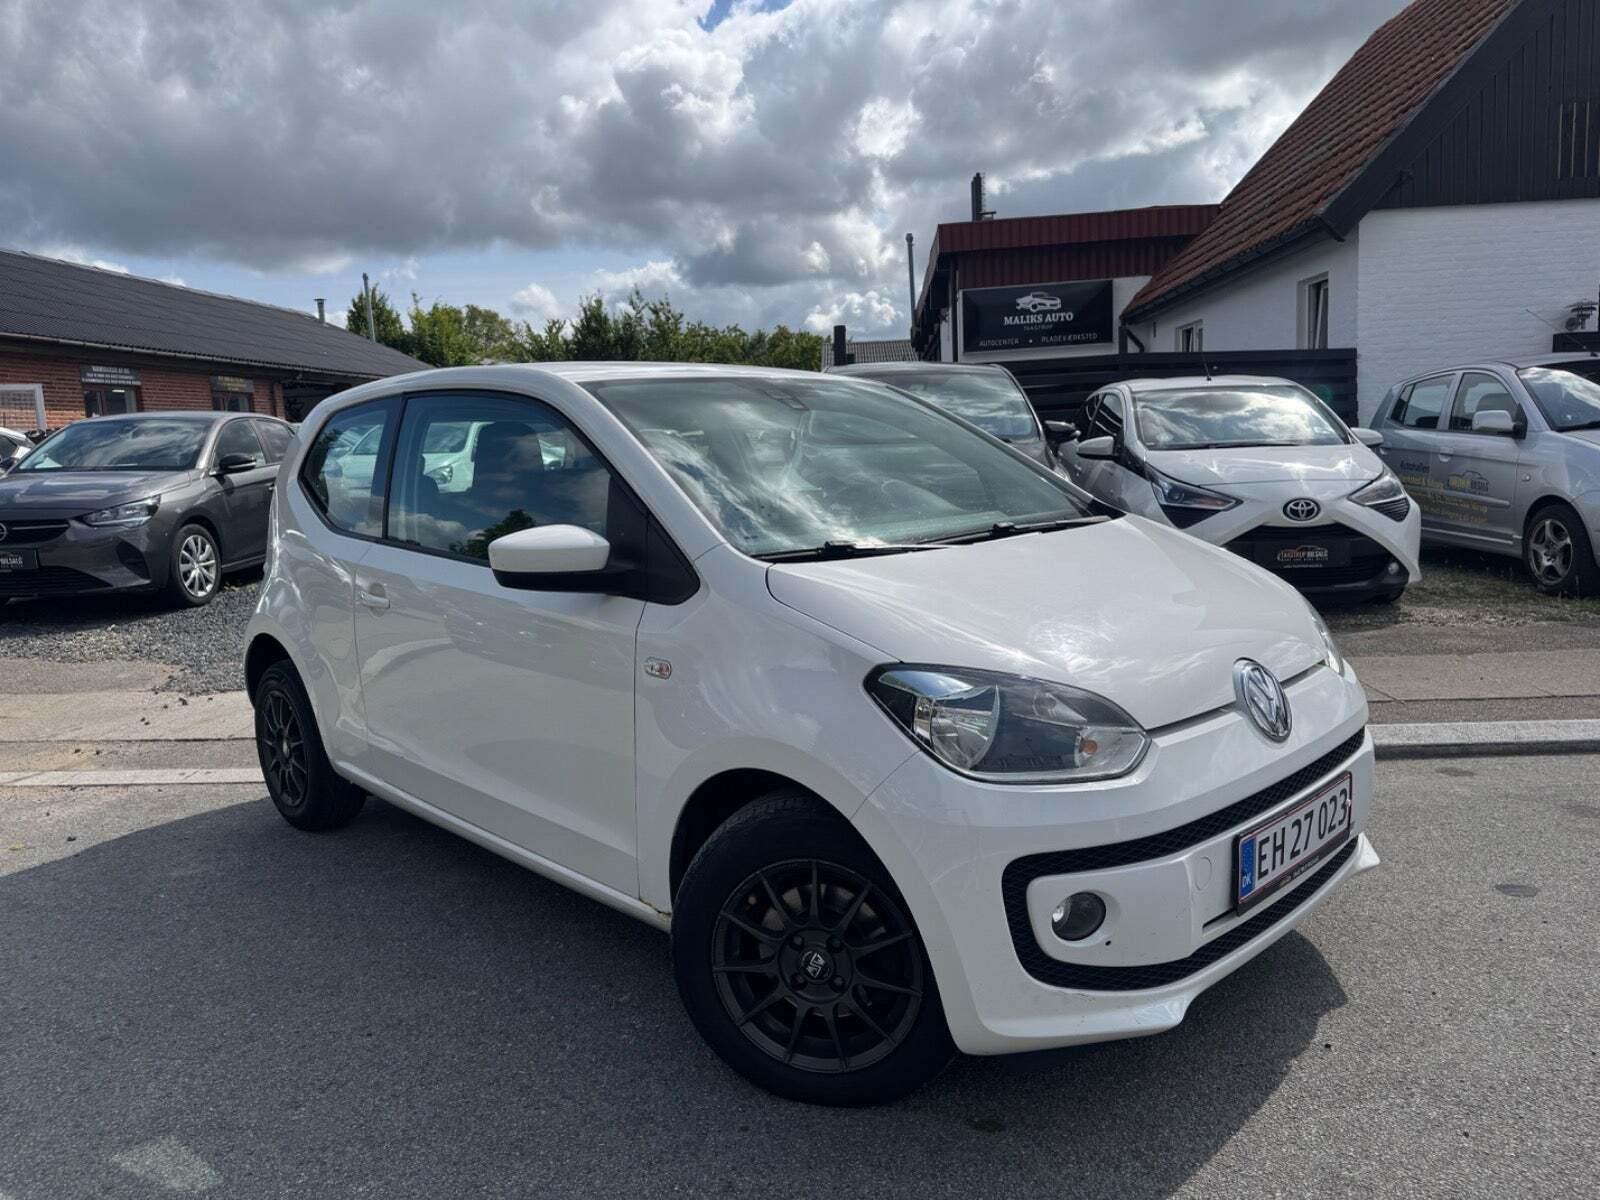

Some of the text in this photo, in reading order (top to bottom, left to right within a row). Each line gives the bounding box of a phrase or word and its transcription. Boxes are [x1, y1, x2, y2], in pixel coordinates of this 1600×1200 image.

[1004, 312, 1074, 326] MALIKS AUTO
[1257, 827, 1286, 880] EH
[1289, 809, 1314, 860] 27
[1318, 788, 1348, 839] 023
